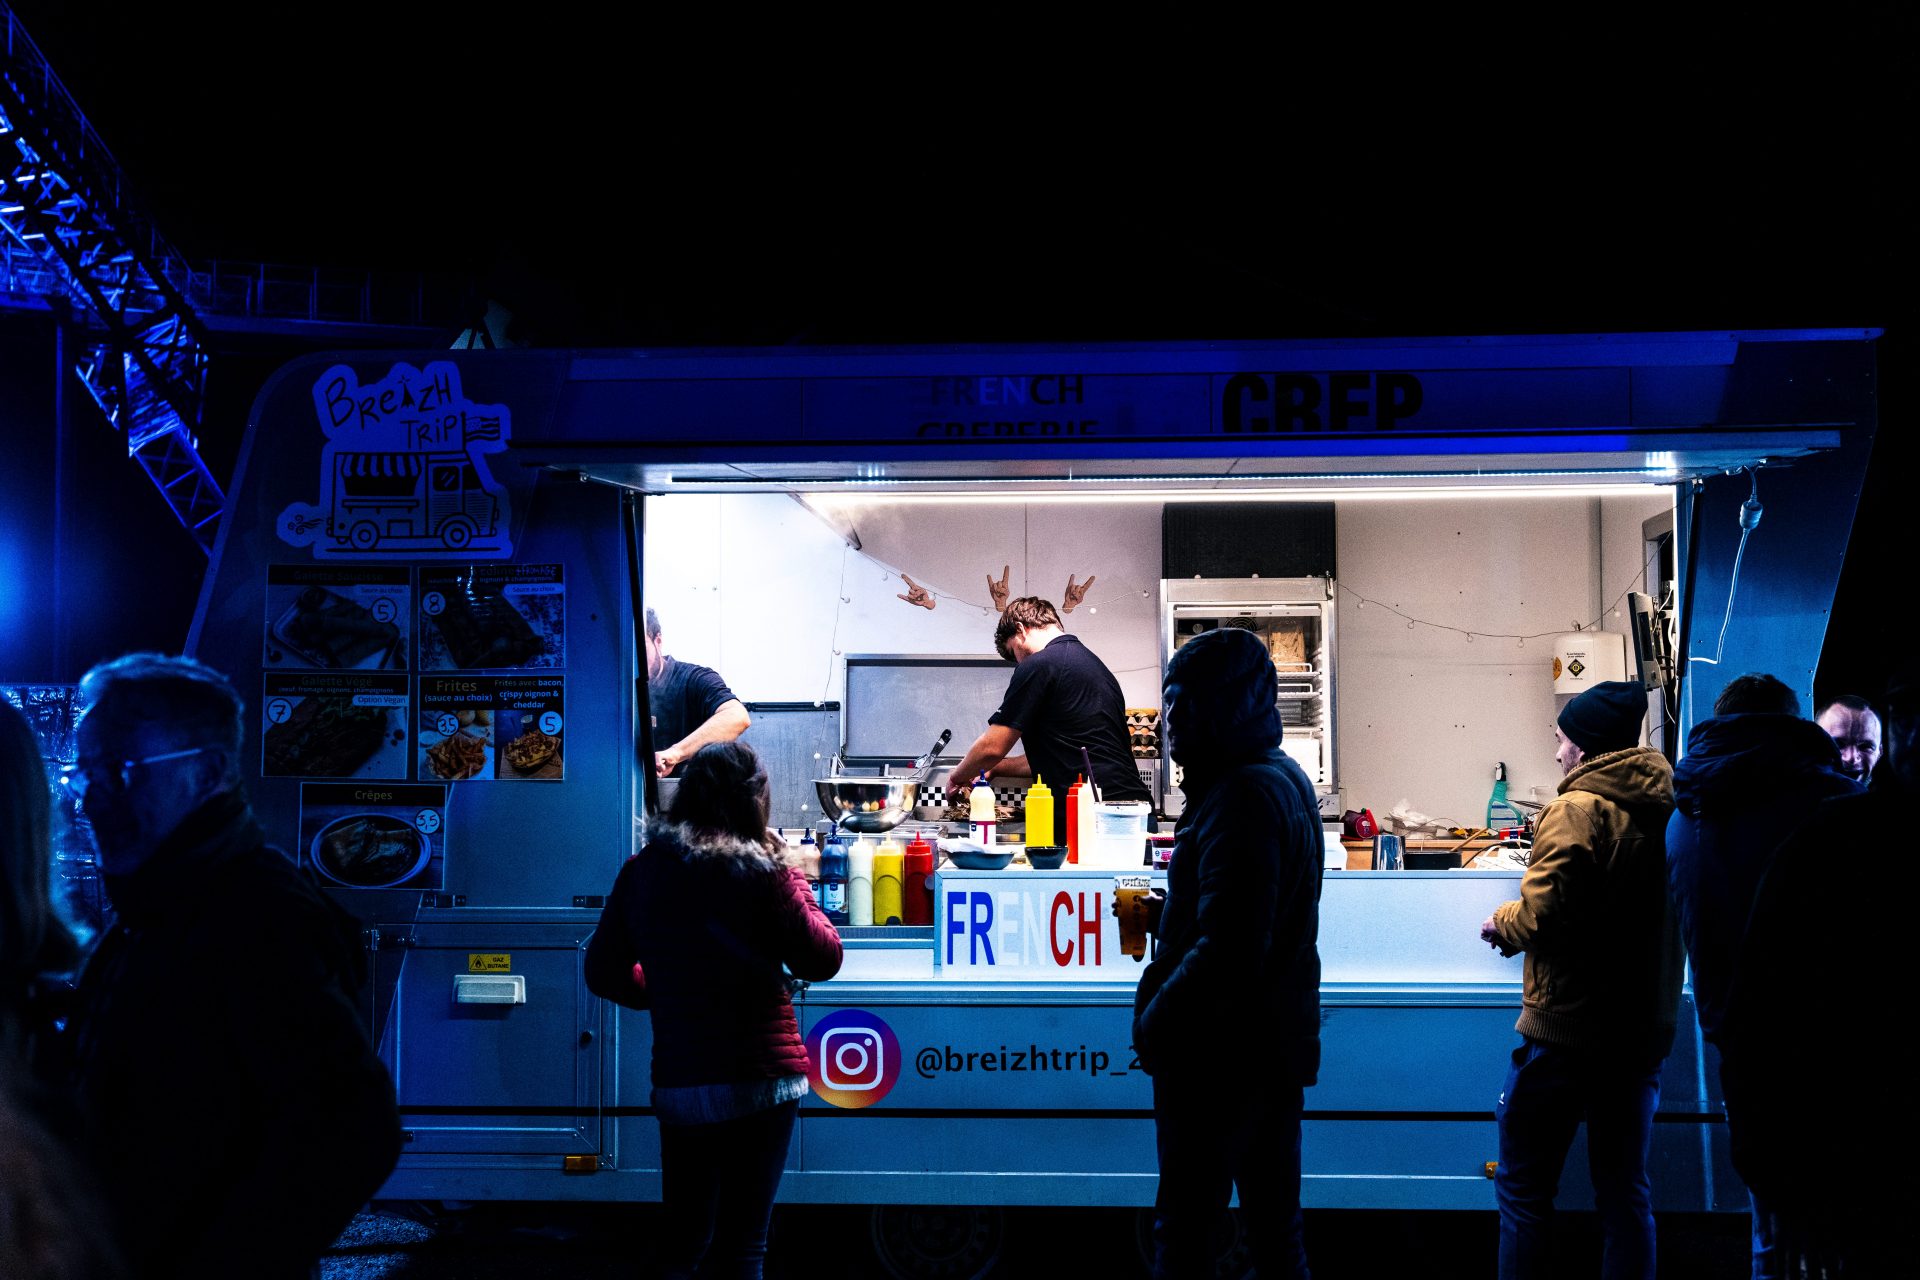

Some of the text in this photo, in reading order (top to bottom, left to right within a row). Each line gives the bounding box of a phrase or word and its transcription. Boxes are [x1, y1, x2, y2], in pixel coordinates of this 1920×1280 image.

[930, 375, 1083, 405] FRENCH
[429, 595, 441, 613] 8
[377, 604, 389, 621] 5
[301, 675, 342, 687] Galette
[436, 680, 478, 692] Frites
[494, 679, 518, 687] Frites
[538, 679, 564, 688] bacon,
[357, 695, 406, 706] Option Vegan
[424, 694, 452, 704] (sauce
[466, 693, 493, 704] choix)
[498, 690, 560, 699] crispy oignon &
[513, 701, 545, 709] cheddar
[272, 704, 286, 722] 7
[545, 716, 556, 733] 5
[354, 789, 393, 803] Crêpes
[947, 890, 1102, 968] FRENCH
